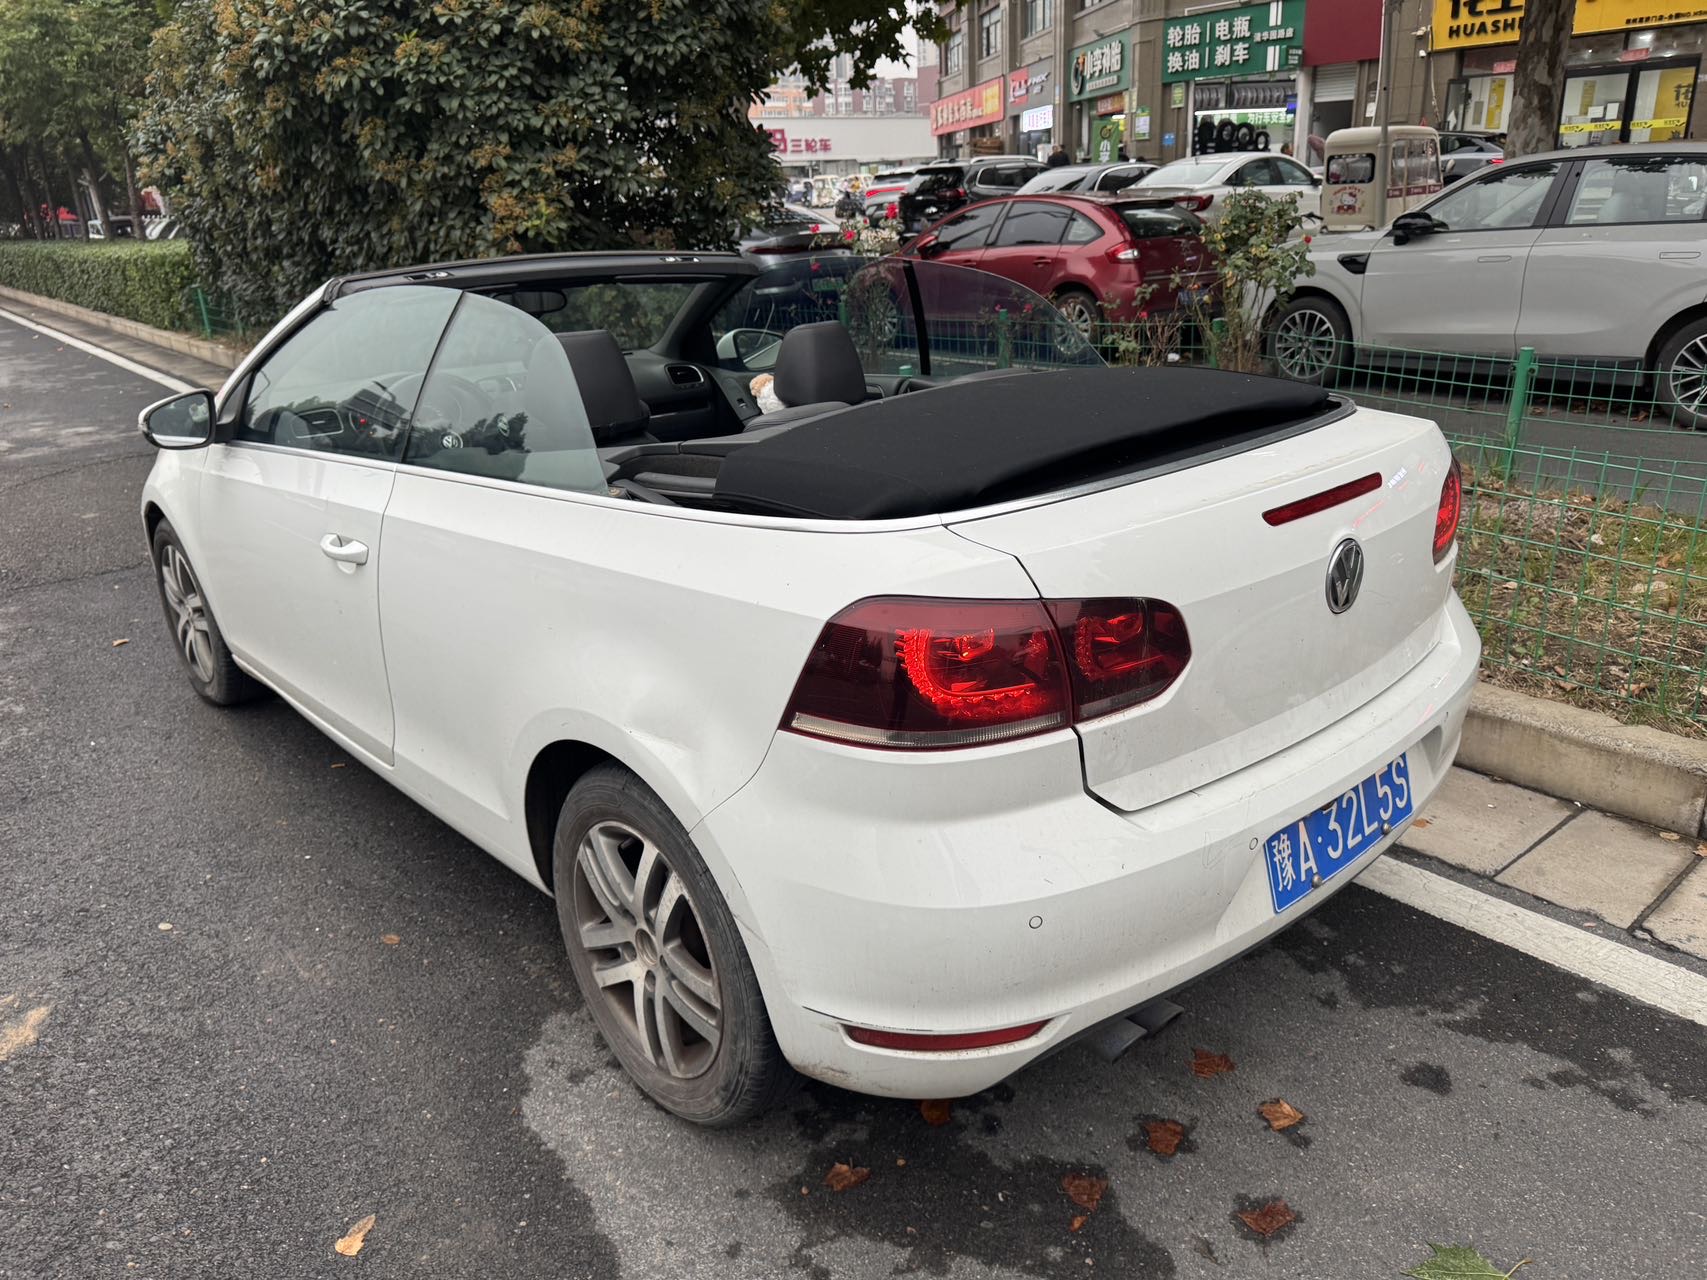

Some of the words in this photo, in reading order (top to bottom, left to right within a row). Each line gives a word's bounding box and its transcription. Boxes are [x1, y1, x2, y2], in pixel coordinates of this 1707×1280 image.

[1167, 23, 1201, 48] 轮胎
[1215, 16, 1251, 41] 电瓶
[1084, 40, 1122, 79] 小李神胎
[1167, 49, 1200, 73] 换油
[1215, 42, 1250, 66] 刹车
[790, 138, 832, 153] 三轮车
